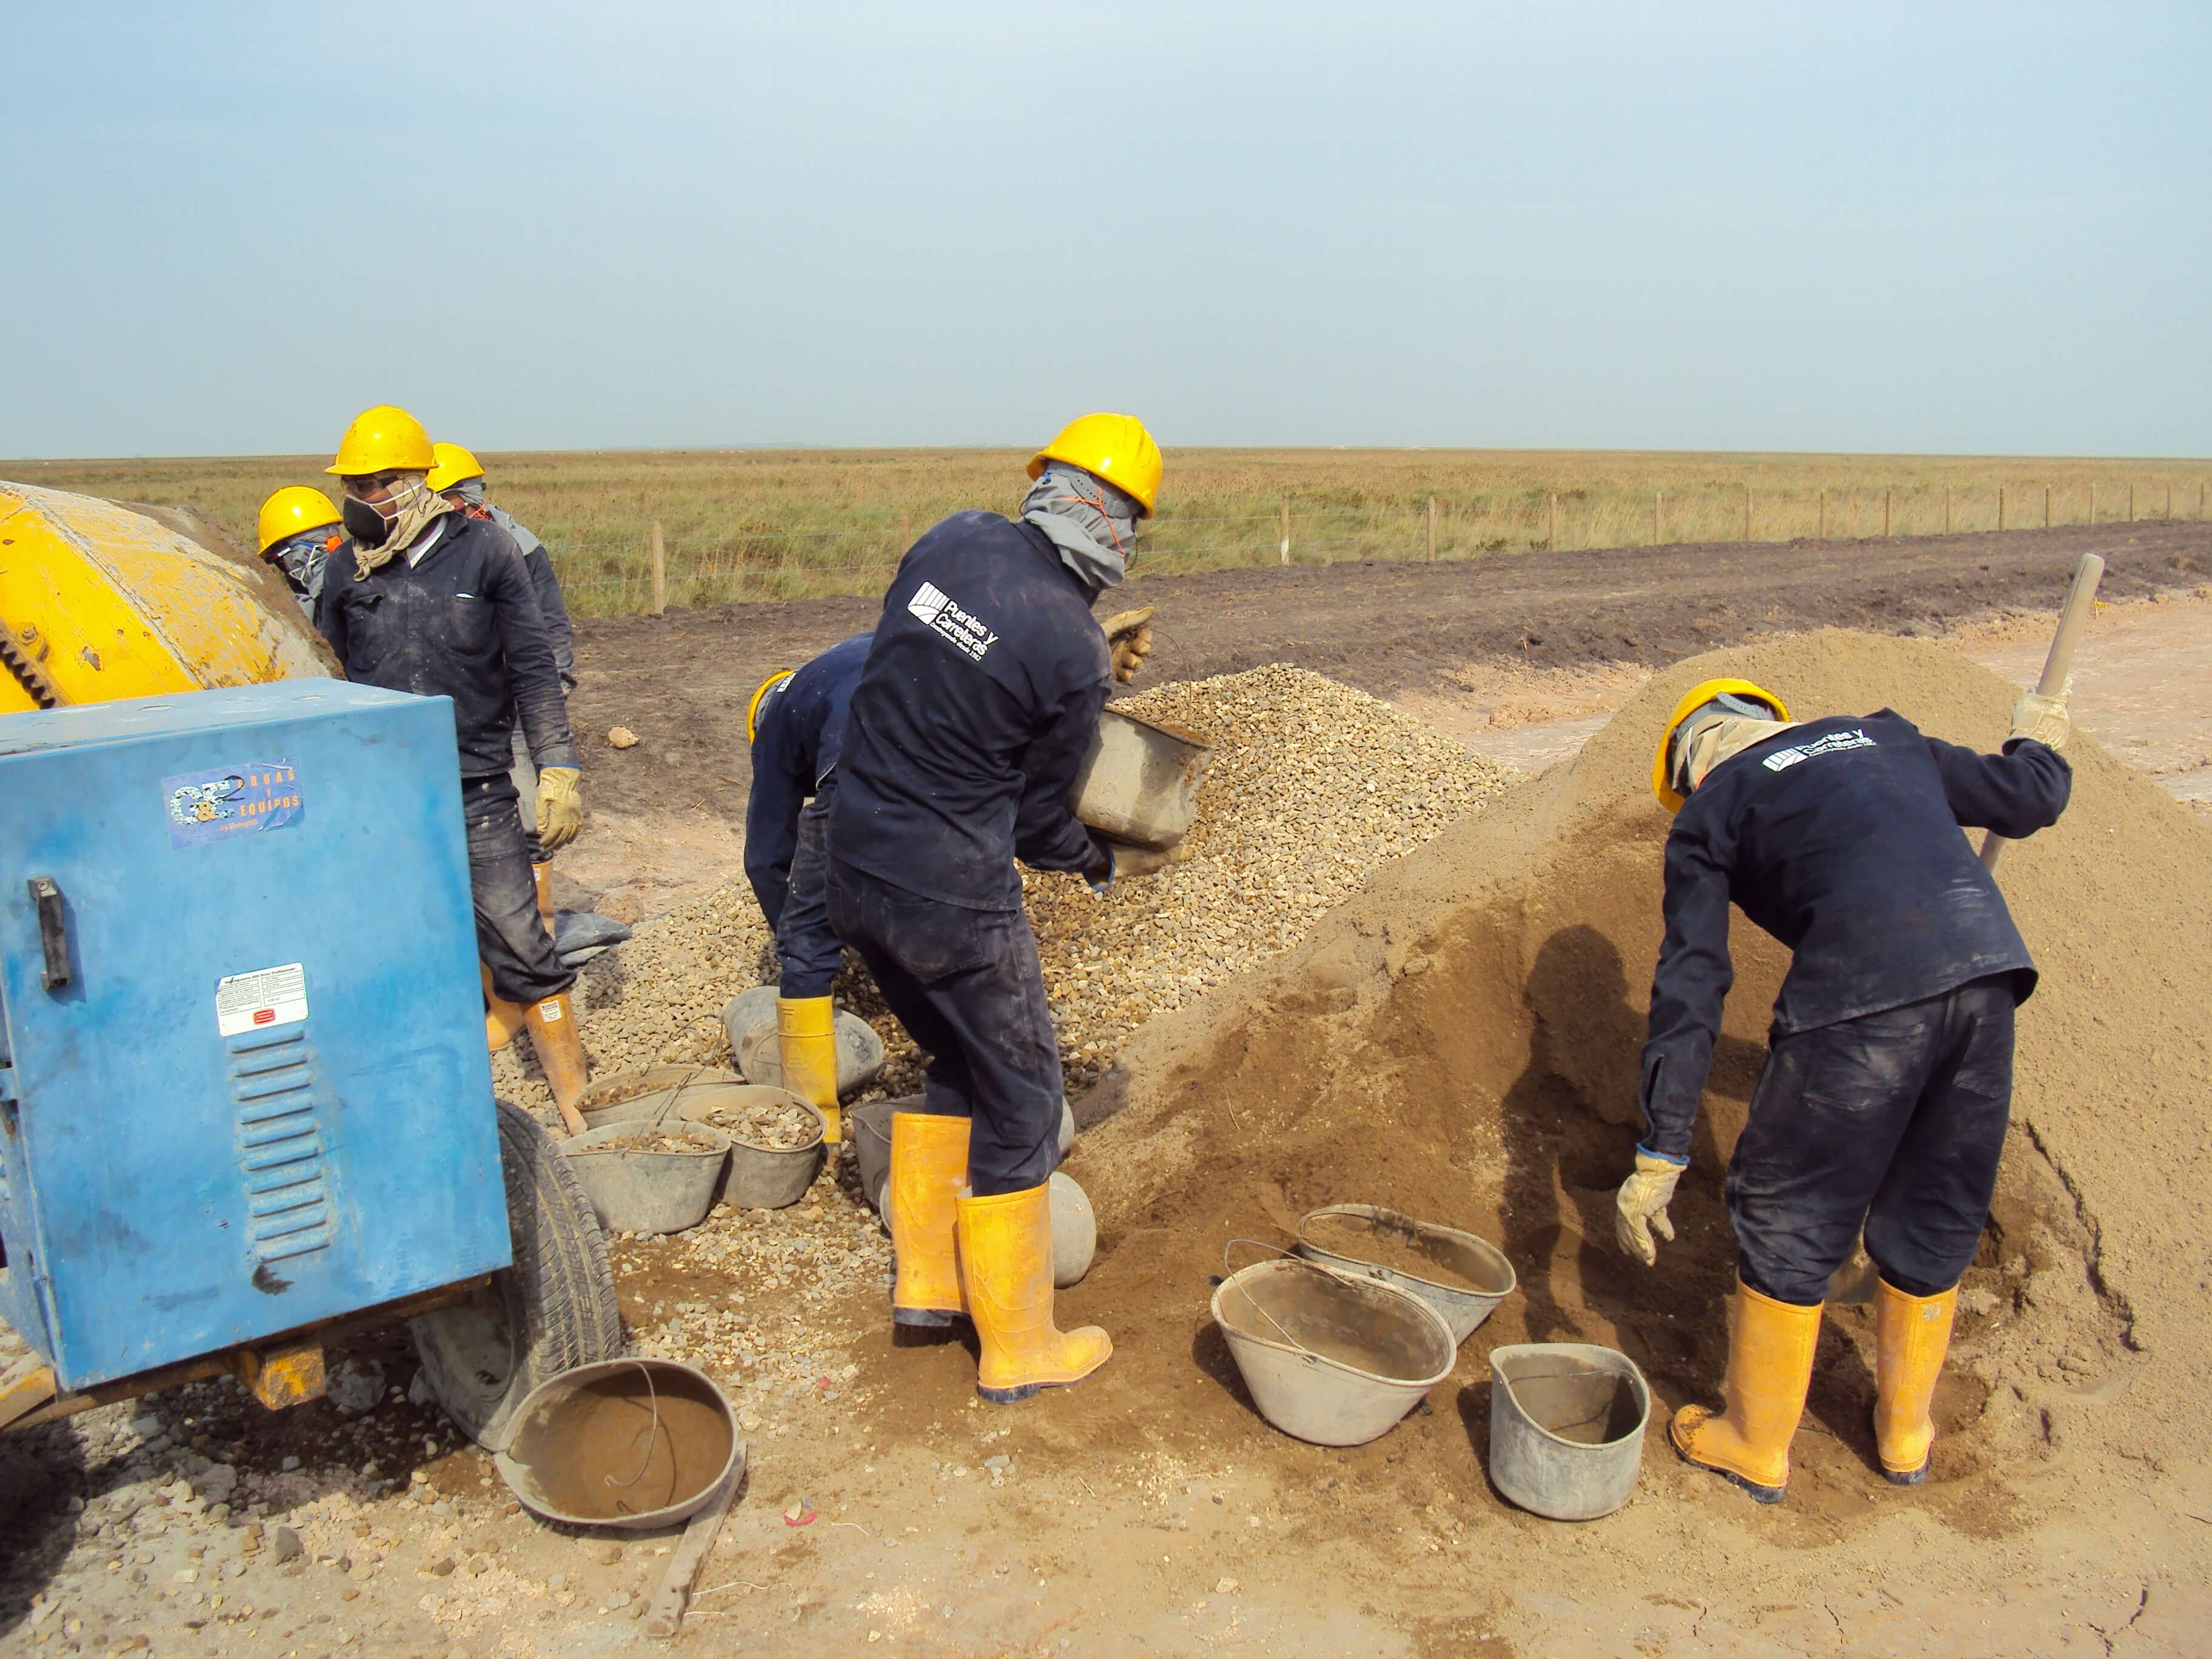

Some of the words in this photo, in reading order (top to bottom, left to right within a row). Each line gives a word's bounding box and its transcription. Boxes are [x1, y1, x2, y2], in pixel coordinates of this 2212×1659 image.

[944, 600, 988, 637] Puentes
[985, 631, 999, 645] y
[936, 613, 988, 655] Carreteras
[1795, 732, 1853, 751] Puentes
[1852, 729, 1864, 738] y
[1803, 737, 1873, 754] Carreteras
[240, 795, 299, 816] EQUIPOS
